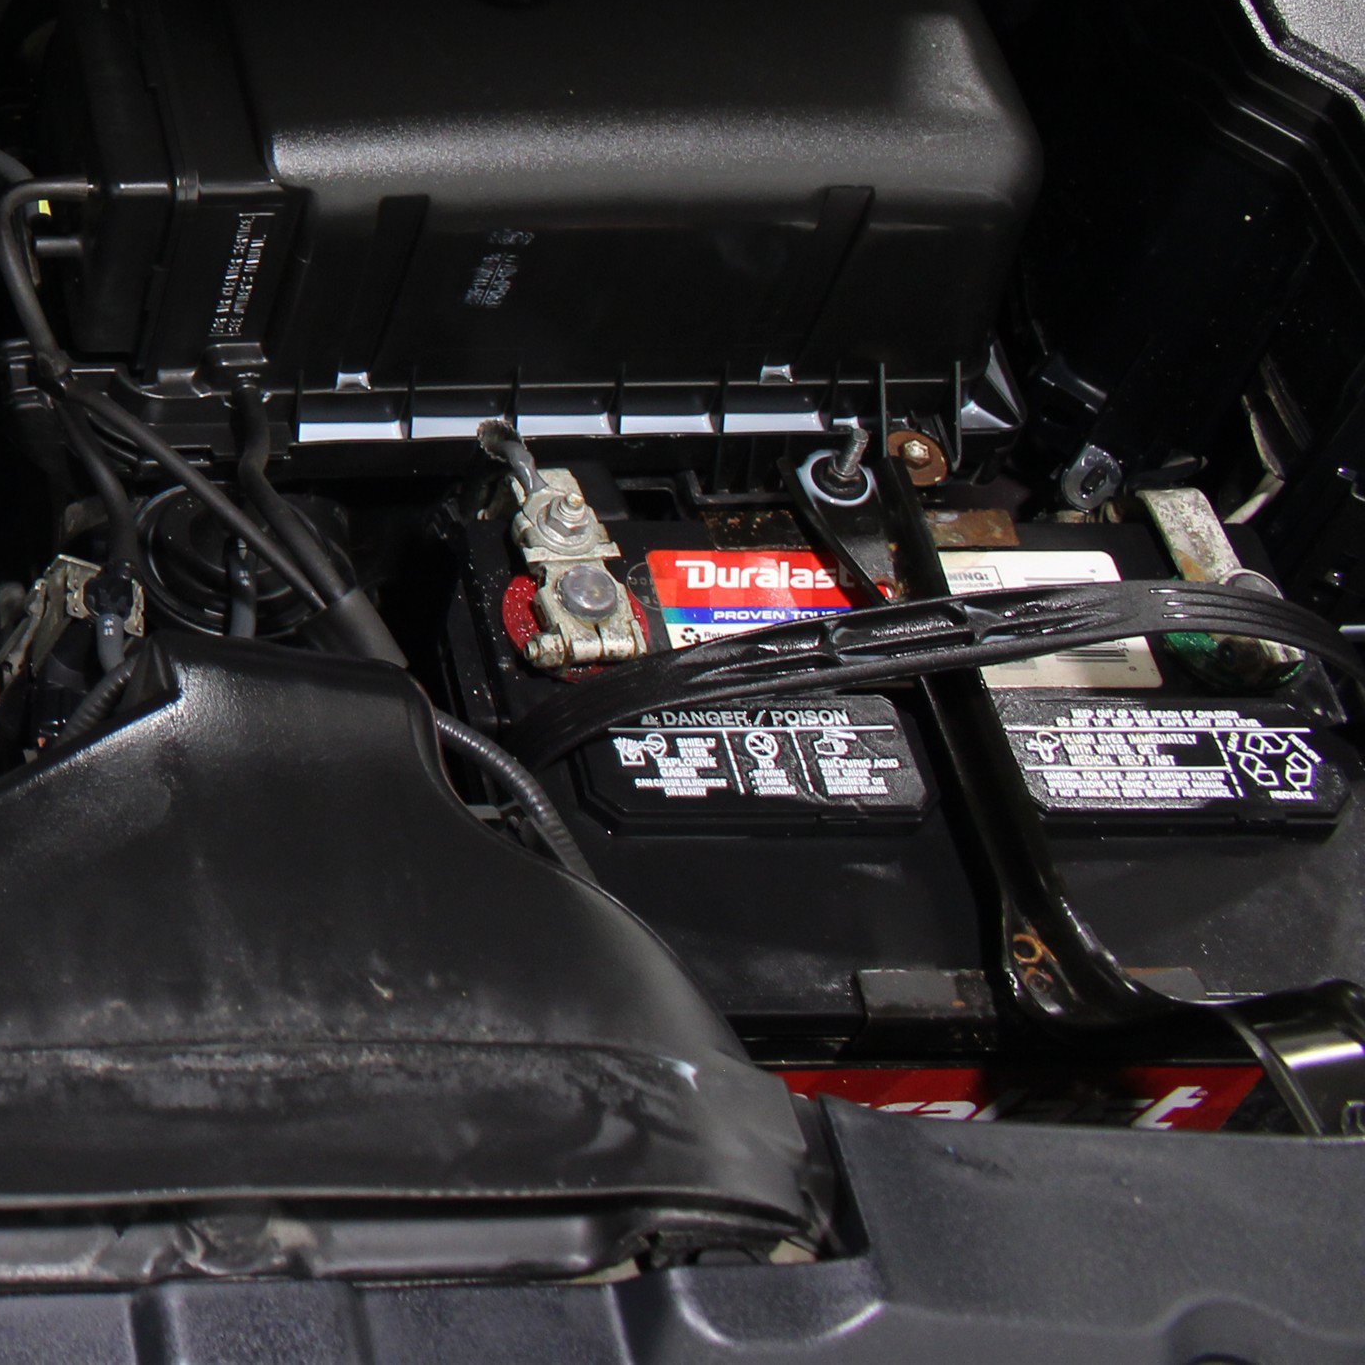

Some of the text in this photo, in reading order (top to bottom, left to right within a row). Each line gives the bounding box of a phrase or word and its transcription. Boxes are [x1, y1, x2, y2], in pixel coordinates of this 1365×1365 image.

[675, 560, 856, 589] Duralast
[713, 610, 785, 621] PROVEN
[661, 711, 748, 726] DANGER
[771, 710, 850, 726] POISON
[1070, 709, 1095, 718] KEEP
[1096, 709, 1115, 718] OUT
[1071, 718, 1090, 726] NOT
[676, 738, 716, 747] SHIELD
[1060, 733, 1197, 745] FLUSH EYES IMMEDIATELY
[1063, 744, 1094, 754] WITH
[1136, 744, 1159, 754] GET
[656, 758, 717, 768] EXPLOSIVE
[758, 759, 775, 769] NO
[818, 758, 900, 768] SULFURIC ACID
[1069, 755, 1175, 765] MEDICAL HELP FAST
[659, 768, 698, 778] GASES
